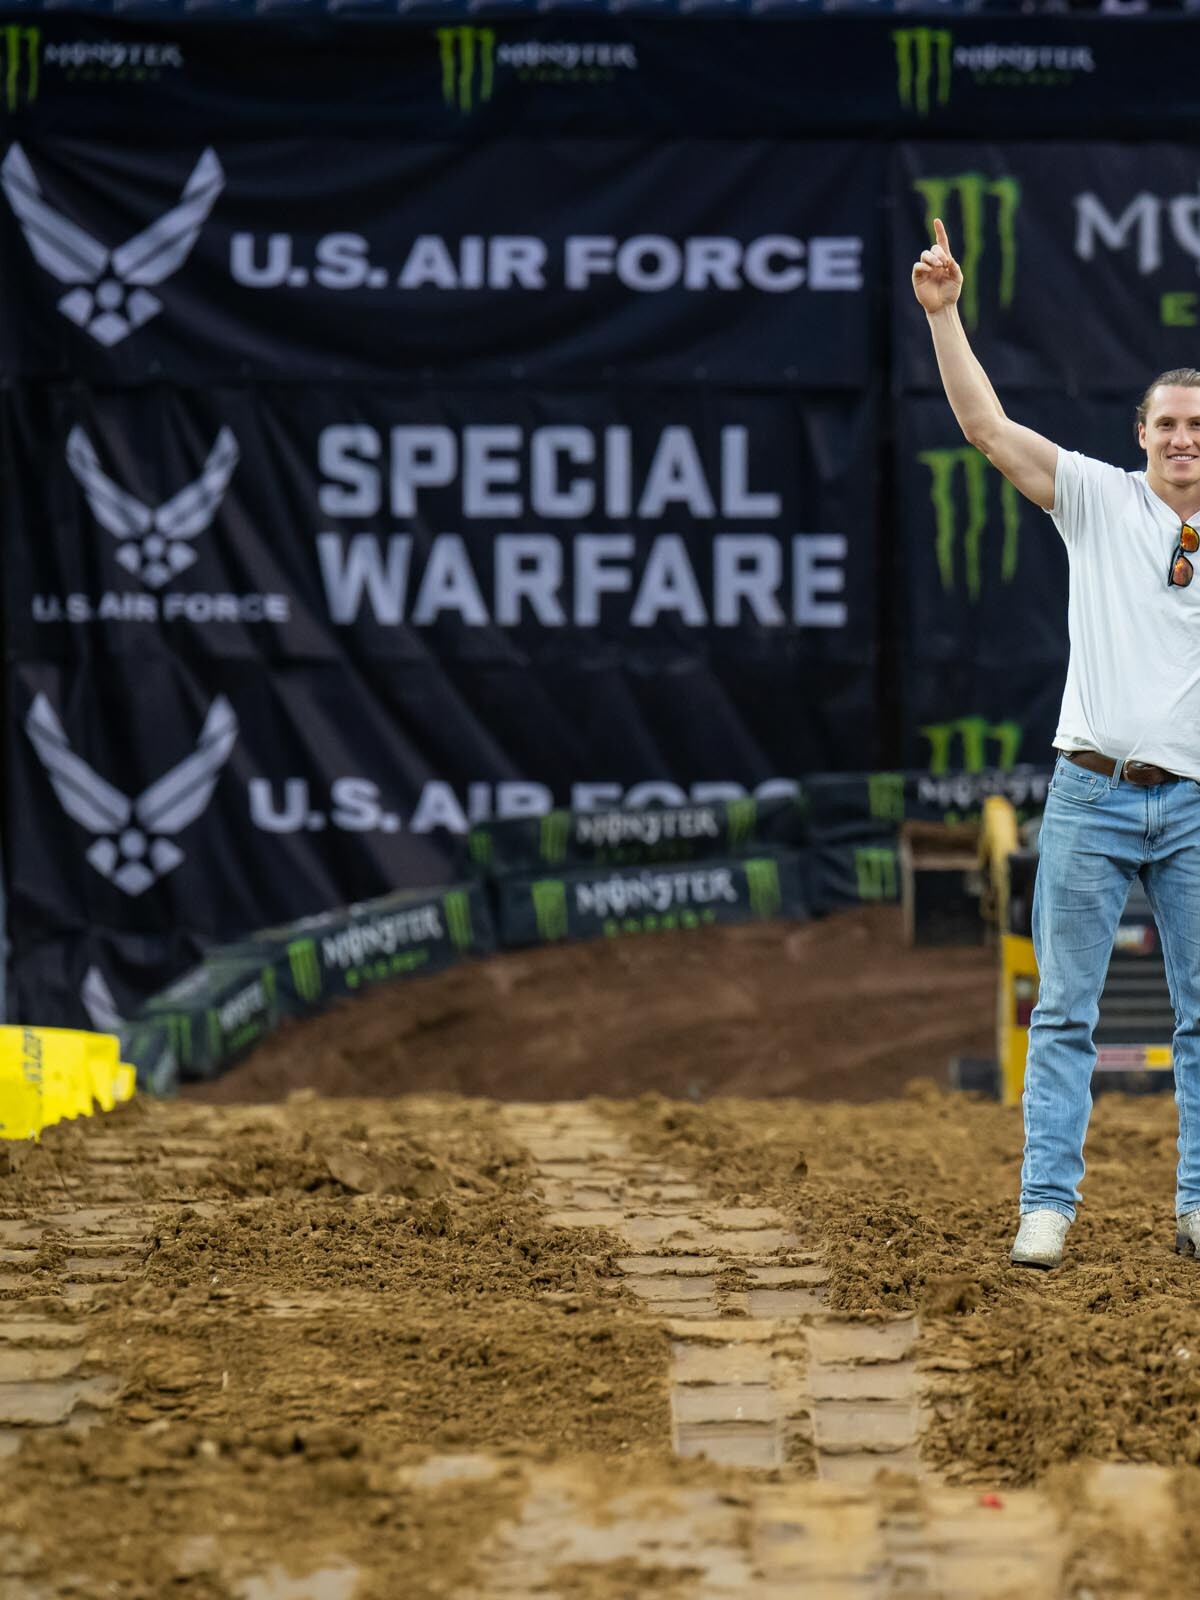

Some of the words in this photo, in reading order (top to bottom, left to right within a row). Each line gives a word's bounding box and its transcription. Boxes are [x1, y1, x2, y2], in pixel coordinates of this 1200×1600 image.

[231, 231, 387, 290] U.S.
[399, 235, 547, 289] AIR
[565, 237, 863, 291] FORCE
[318, 425, 782, 518] SPECIAL
[163, 593, 291, 623] FORCE
[316, 533, 848, 628] WARFARE
[249, 776, 398, 833] U.S.
